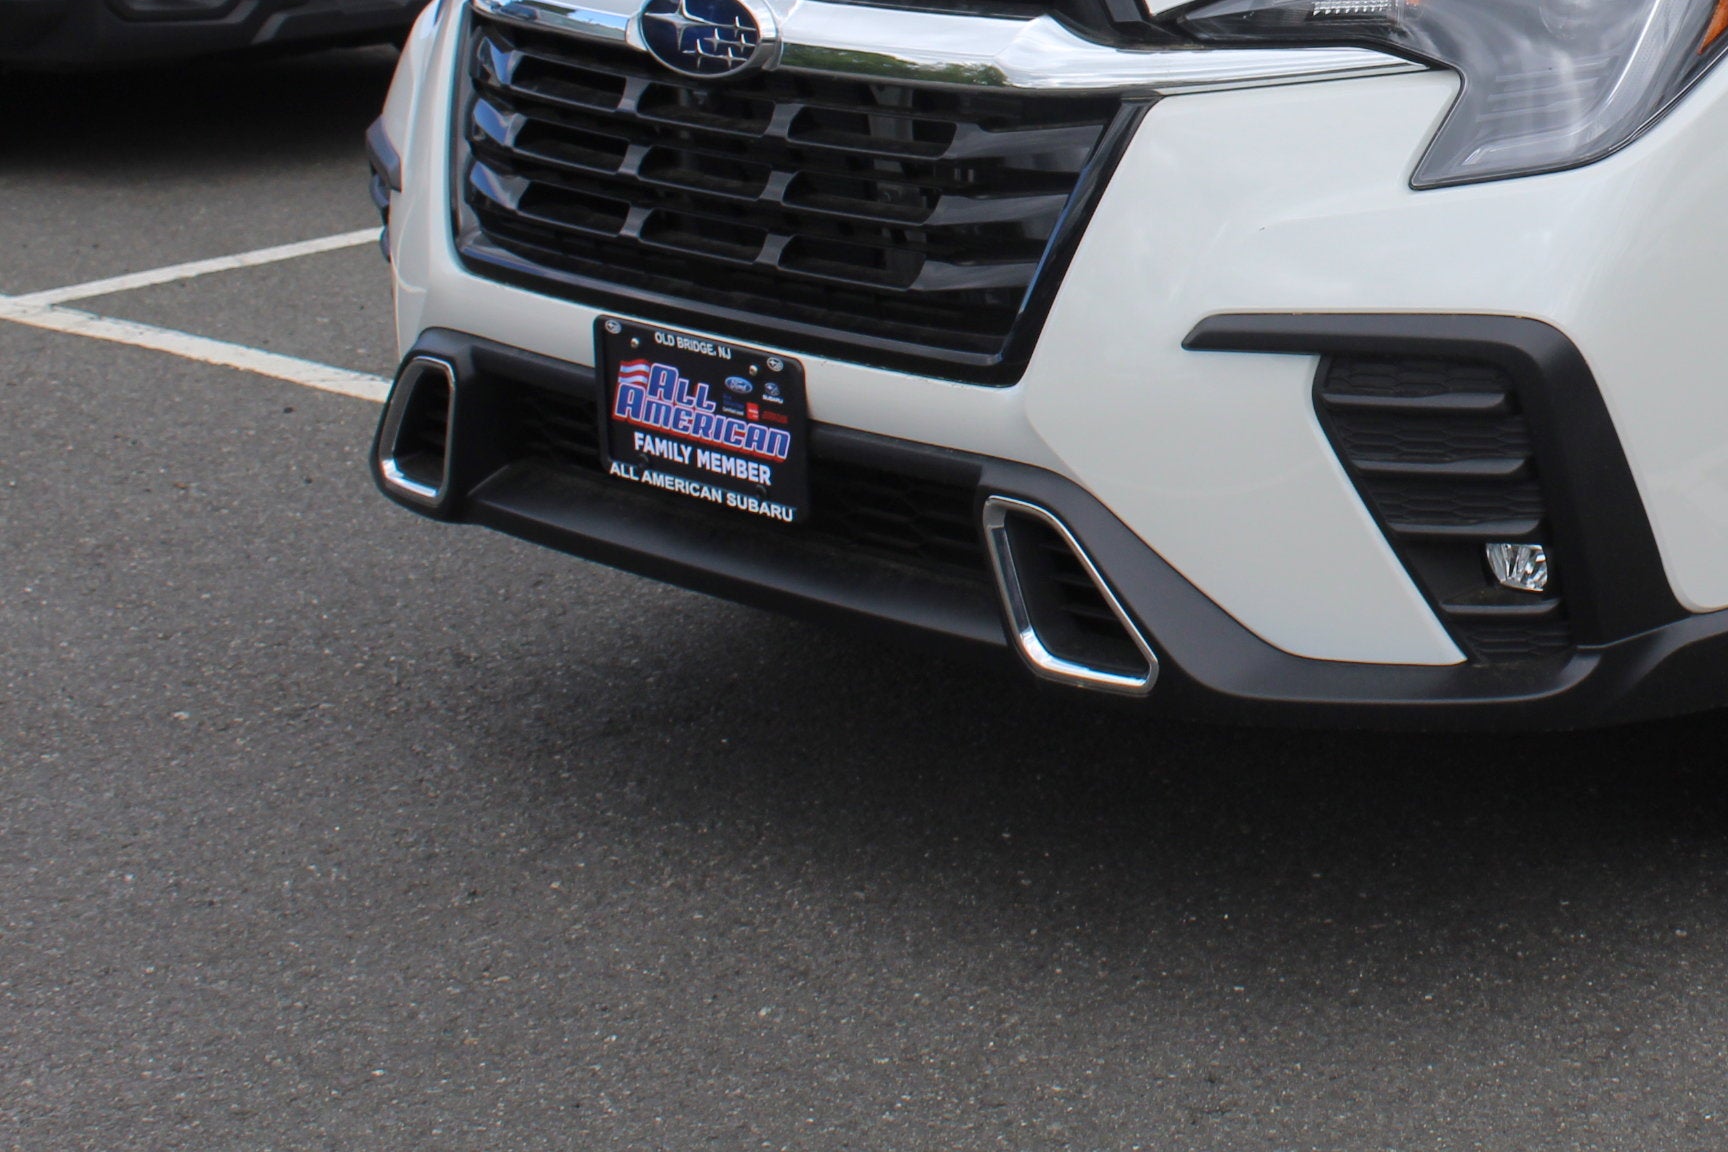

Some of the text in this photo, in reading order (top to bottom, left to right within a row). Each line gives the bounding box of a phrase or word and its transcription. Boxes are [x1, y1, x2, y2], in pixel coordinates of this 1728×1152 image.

[654, 331, 675, 347] OLD
[718, 347, 732, 360] NJ
[647, 362, 717, 412] ALL
[613, 382, 791, 461] AMERICAN
[633, 431, 772, 486] FAMILY MEMBER
[609, 462, 794, 523] ALL AMERICAN SUBARU
